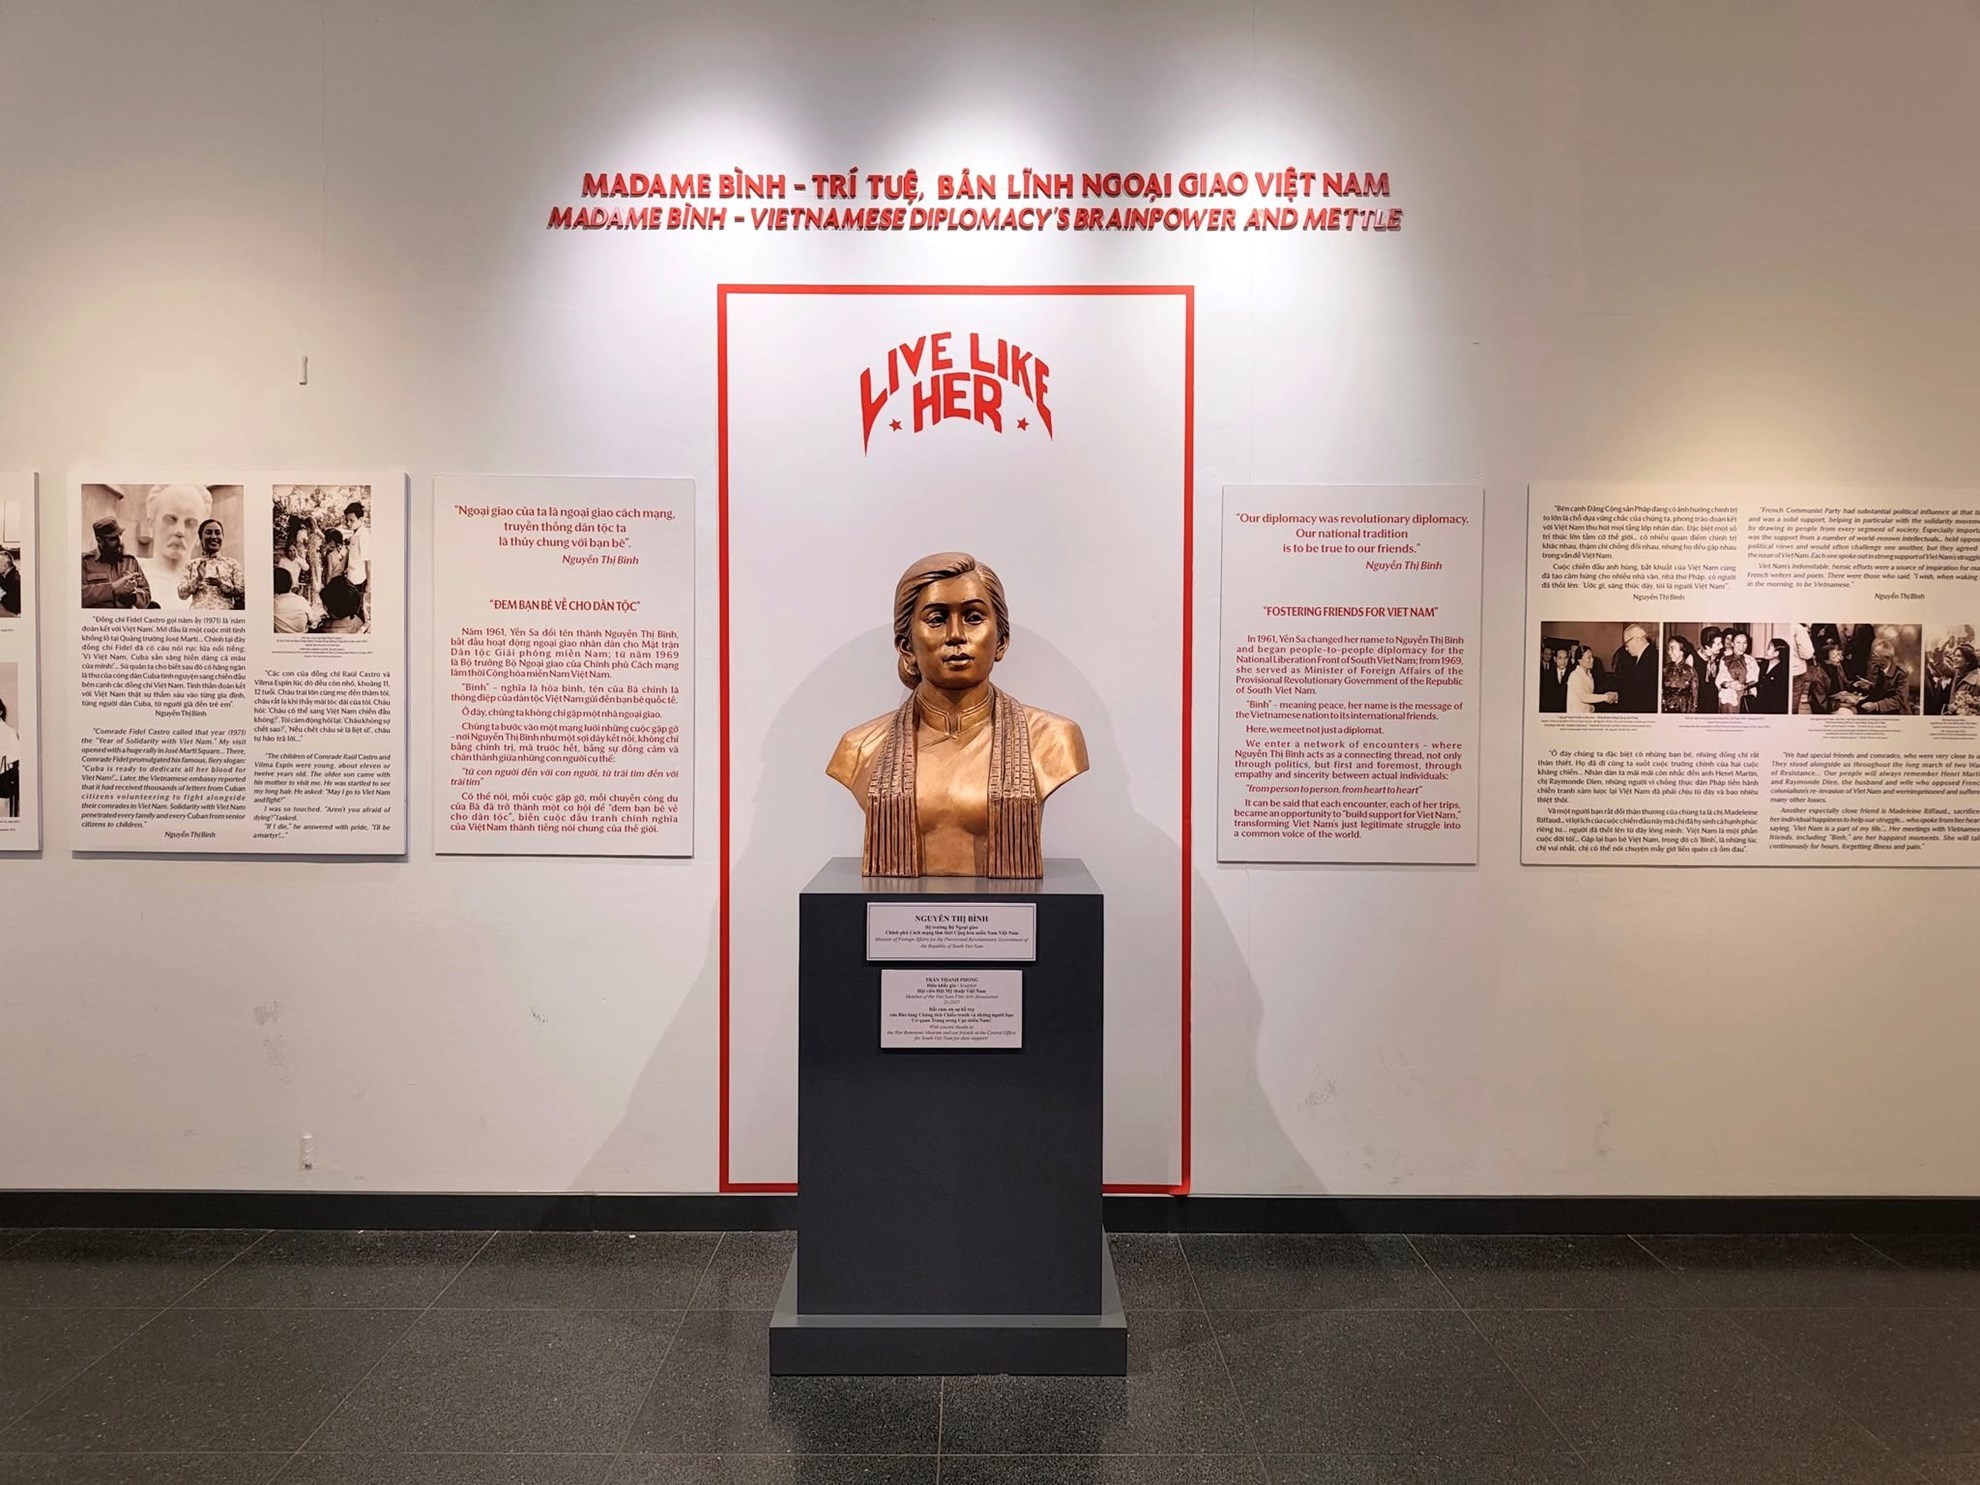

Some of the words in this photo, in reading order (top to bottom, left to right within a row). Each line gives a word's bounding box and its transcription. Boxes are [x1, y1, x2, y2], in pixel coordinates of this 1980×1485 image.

[582, 173, 713, 198] MADAME
[719, 166, 786, 199] BÌNH
[812, 166, 858, 199] TRÍ
[866, 169, 924, 204] TUỆ,
[937, 168, 996, 199] BẢN
[1007, 168, 1075, 199] LĨNH
[1082, 173, 1172, 202] NGOẠI
[1179, 172, 1248, 197] GIAO
[1255, 166, 1316, 202] VIỆT
[1323, 172, 1390, 197] NAM
[547, 206, 663, 230] MADAME
[667, 202, 727, 230] BÌNH
[751, 207, 904, 231] VIETNAMESE
[909, 207, 1070, 231] DIPLOMACY'S
[1074, 207, 1236, 231] BRAINPOWER
[1244, 207, 1298, 231] AND
[1304, 208, 1403, 231] METTLE
[860, 332, 953, 458] LIVE
[970, 333, 1053, 441] LIKE
[913, 372, 1003, 433] HER
[491, 506, 514, 518] giao
[515, 506, 535, 516] của
[536, 507, 547, 516] ta
[549, 507, 559, 517] là
[560, 507, 590, 519] ngoại
[591, 507, 614, 520] giao
[615, 508, 641, 518] cách
[1262, 513, 1316, 525] diplomacy
[1319, 515, 1338, 524] was
[1341, 514, 1410, 526] revolutionary
[504, 520, 539, 534] truyền
[541, 521, 573, 534] thống
[574, 522, 595, 532] dân
[596, 523, 615, 534] tộc
[616, 524, 627, 533] ta
[1296, 528, 1316, 538] Our
[1319, 528, 1360, 538] national
[1363, 528, 1408, 539] tradition
[499, 536, 508, 546] là
[510, 536, 535, 549] thủy
[536, 537, 570, 549] chung
[571, 537, 588, 547] với
[589, 538, 610, 549] bạn
[1283, 543, 1292, 553] is
[1293, 544, 1304, 553] to
[1305, 543, 1319, 553] be
[1321, 544, 1343, 553] true
[1344, 544, 1356, 553] to
[562, 554, 599, 566] Nguyễn
[601, 555, 616, 566] Thị
[617, 555, 639, 565] Bình
[1365, 560, 1403, 572] Nguyễn
[1404, 560, 1420, 571] Thị
[1420, 561, 1443, 570] Bình
[518, 600, 540, 612] BẠN
[540, 598, 553, 610] BÈ
[554, 598, 568, 610] VỀ
[568, 601, 592, 611] CHO
[593, 599, 615, 611] DÂN
[1323, 606, 1365, 617] FRIENDS
[1365, 607, 1386, 617] FOR
[1386, 607, 1409, 617] VIET
[1236, 645, 1254, 653] and
[1258, 645, 1286, 656] began
[1290, 645, 1374, 656] people-to-people
[1377, 645, 1426, 656] diplomacy
[1431, 646, 1444, 655] for
[1449, 646, 1464, 655] the
[1236, 665, 1252, 674] she
[1256, 665, 1287, 674] served
[1304, 666, 1344, 674] Minister
[1347, 666, 1358, 675] of
[1360, 666, 1396, 677] Foreign
[1399, 666, 1431, 675] Affairs
[1434, 667, 1445, 675] of
[1448, 666, 1464, 675] the
[1236, 675, 1283, 684] Provisional
[1283, 676, 1343, 686] Revolutionary
[1344, 676, 1398, 685] Government
[1399, 677, 1409, 685] of
[1410, 676, 1425, 685] the
[1425, 677, 1463, 687] Republic
[1235, 685, 1245, 694] of
[1247, 685, 1272, 694] South
[1275, 686, 1292, 695] Viet
[117, 793, 170, 802] volunteering
[183, 794, 204, 802] fight
[206, 794, 246, 803] alongside
[915, 914, 950, 922] NGUYỄN
[951, 915, 966, 924] THỊ
[968, 914, 989, 922] BÌNH
